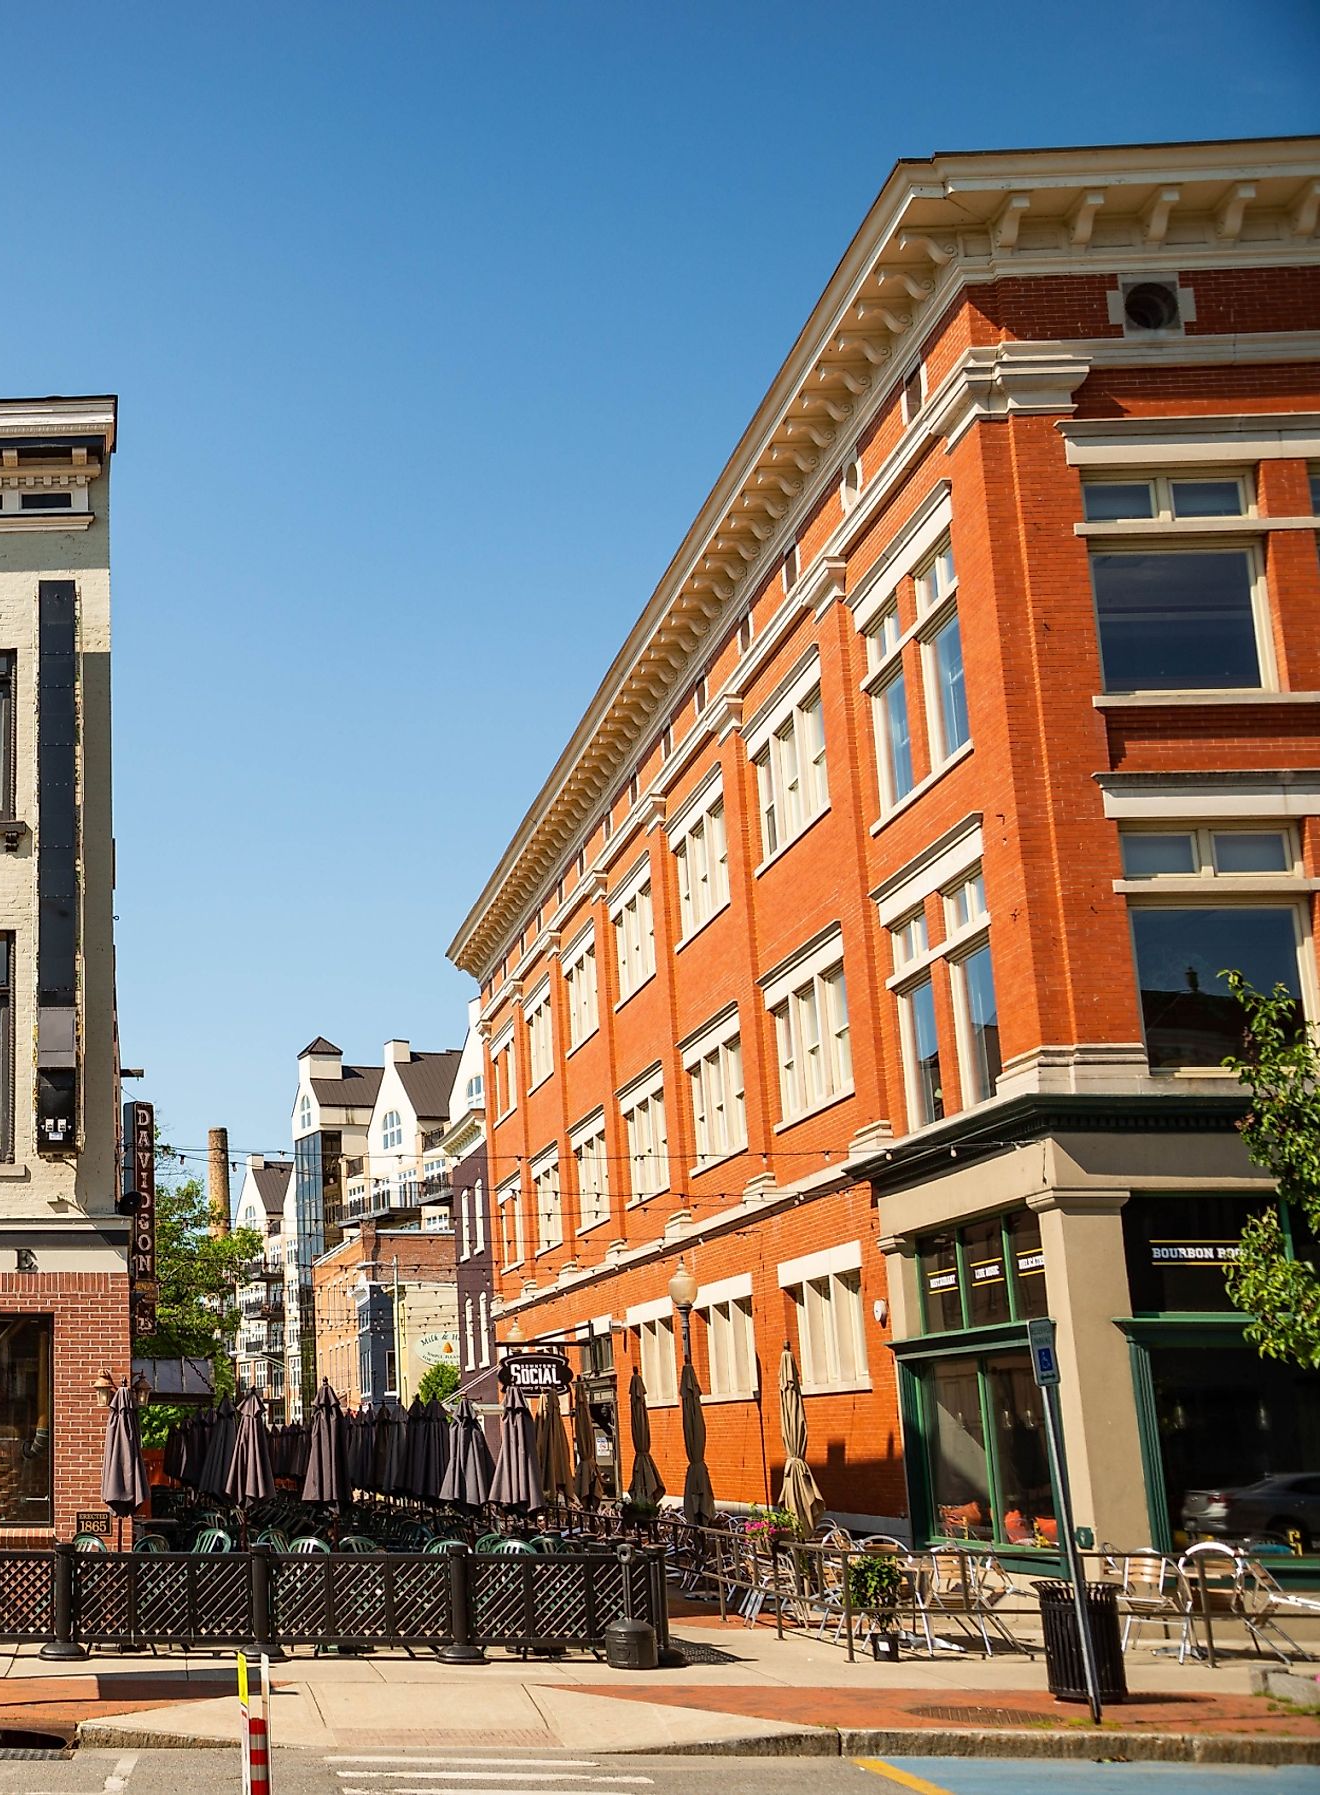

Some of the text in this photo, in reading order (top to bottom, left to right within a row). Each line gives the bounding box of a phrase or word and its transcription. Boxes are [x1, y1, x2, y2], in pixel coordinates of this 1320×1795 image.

[137, 1109, 153, 1272] DAVIDSON
[1151, 1247, 1247, 1259] BOURBON ROO
[452, 1333, 460, 1341] H
[510, 1363, 561, 1385] SOCIAL
[80, 1520, 107, 1532] 1865
